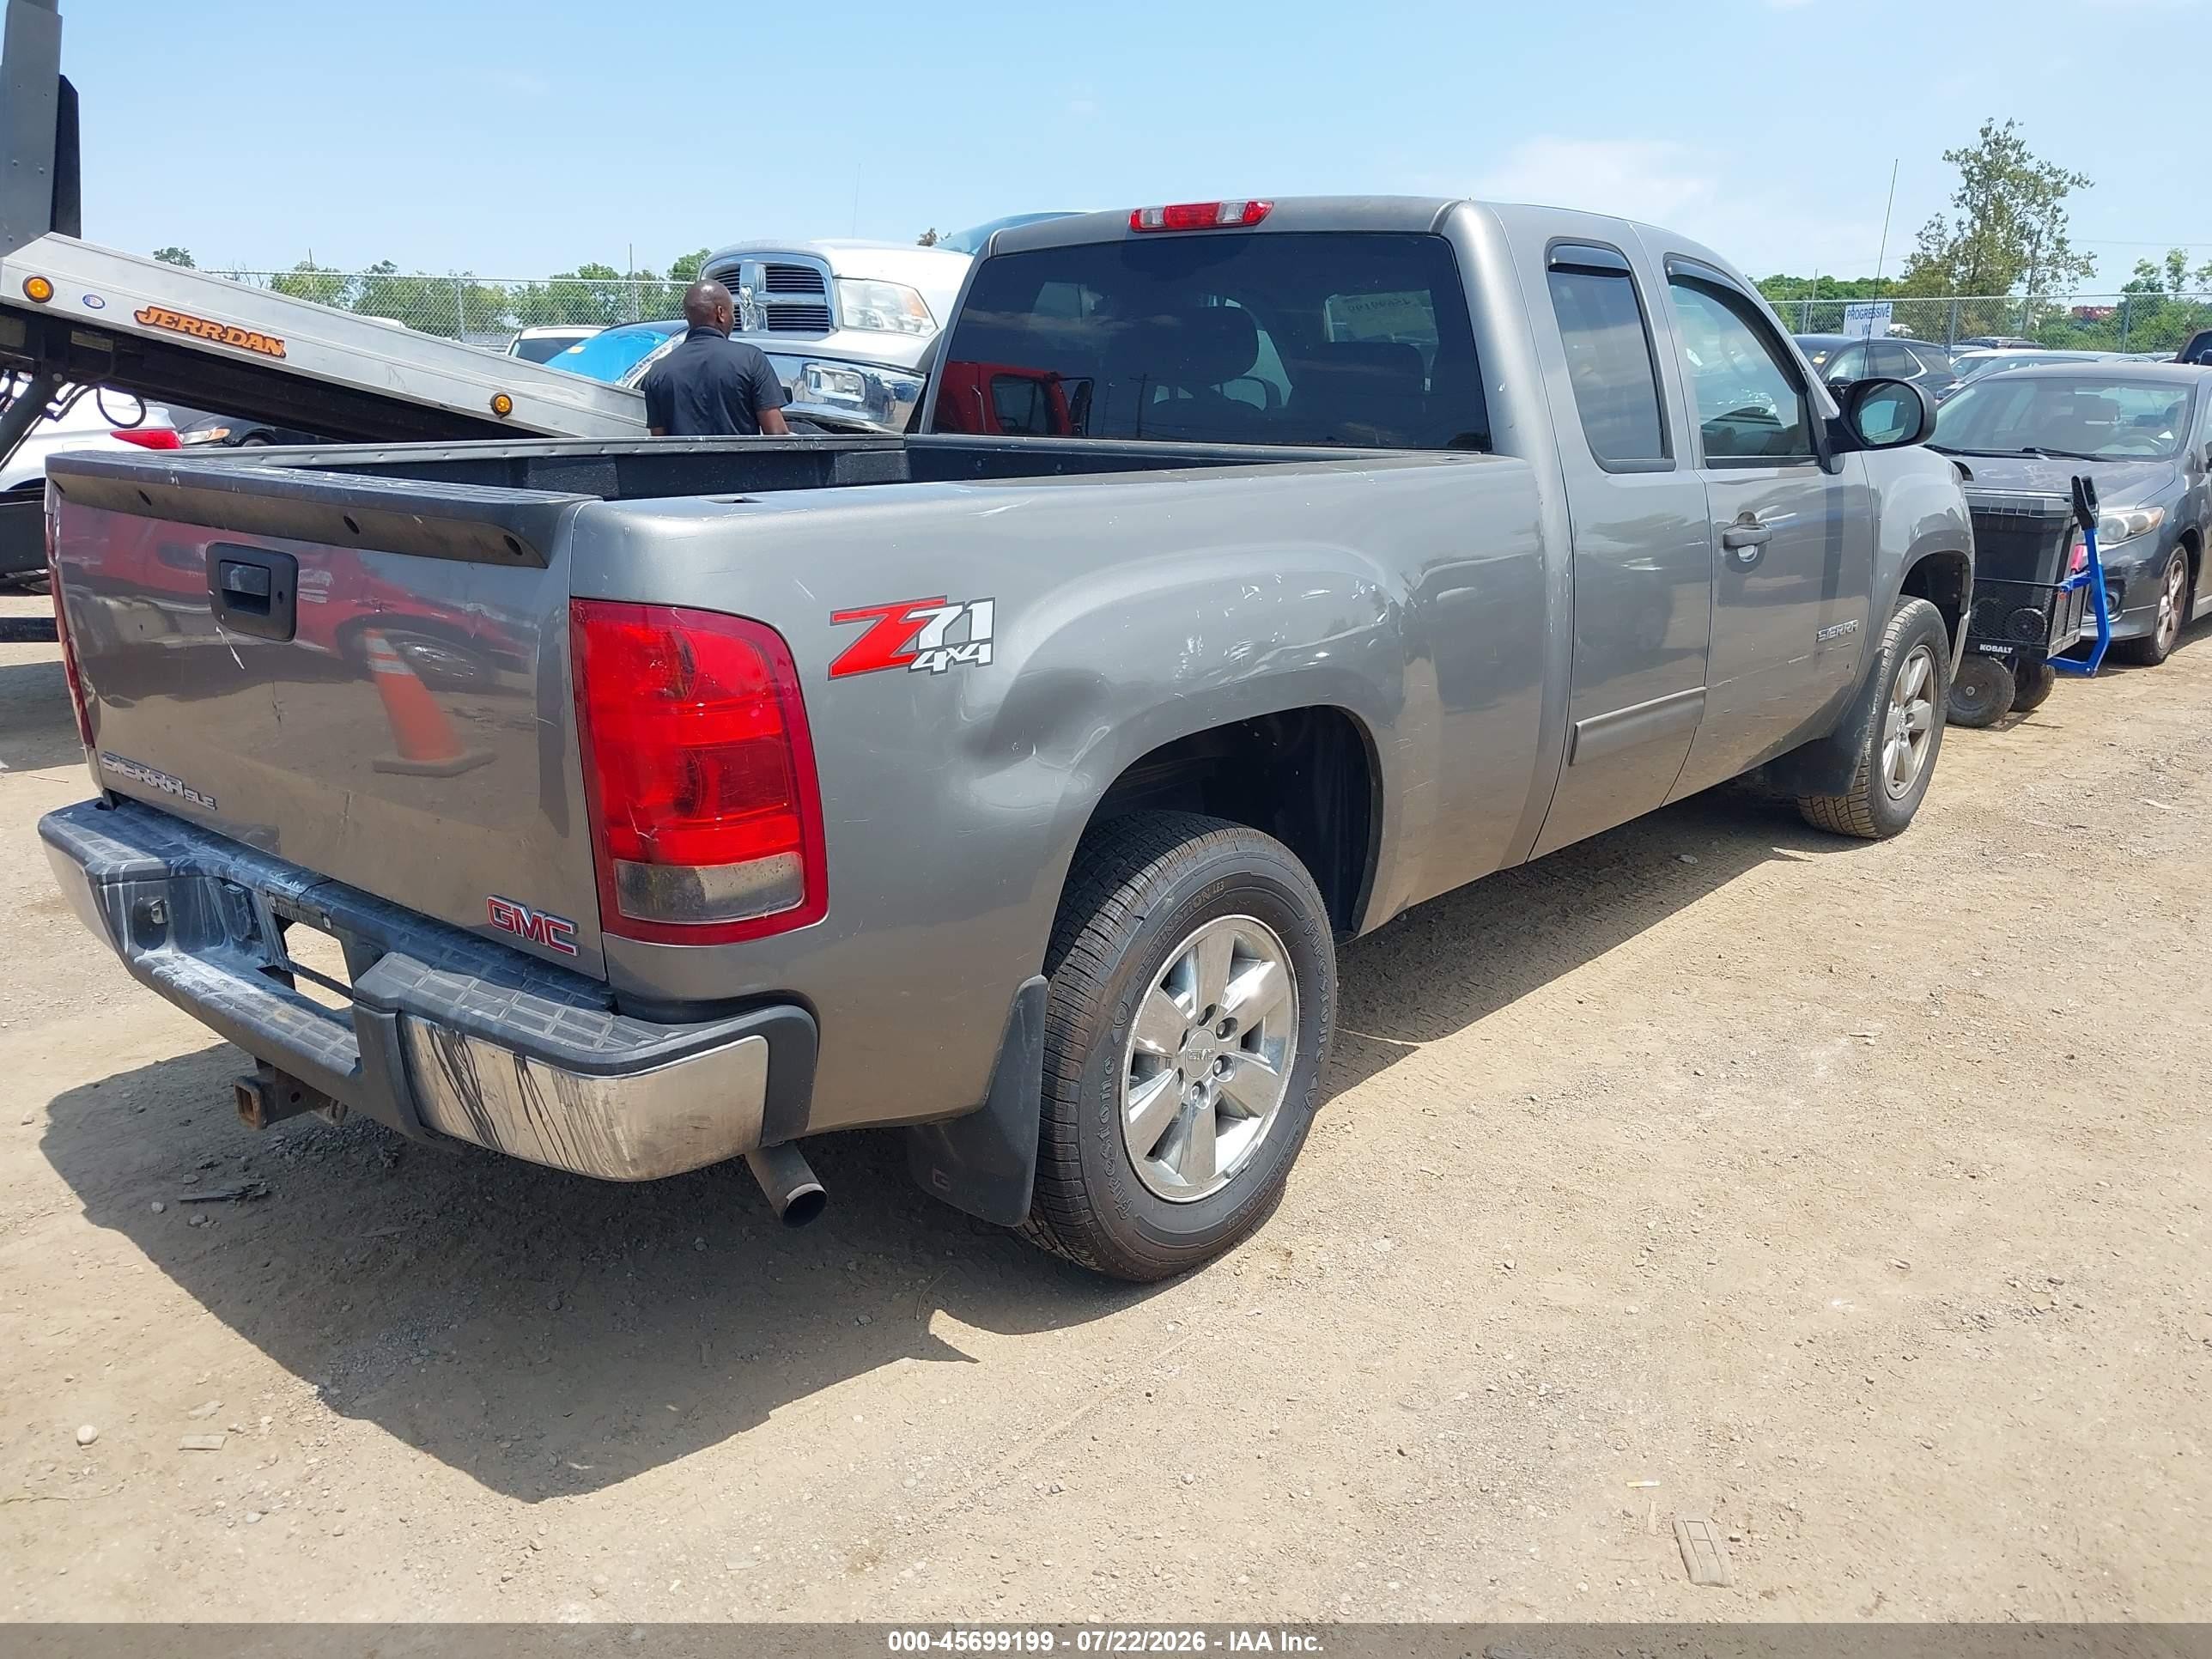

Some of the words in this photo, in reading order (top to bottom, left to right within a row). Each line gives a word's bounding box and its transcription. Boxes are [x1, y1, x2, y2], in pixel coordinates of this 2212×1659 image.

[1846, 307, 1890, 321] PROGRESSIVE
[828, 595, 996, 681] Z71
[1816, 619, 1859, 643] SIERRA
[1978, 643, 2014, 654] KOBALT
[101, 750, 185, 798] SIERRA
[184, 787, 218, 811] SLE
[487, 894, 580, 957] GMC
[1097, 1055, 1134, 1220] Firestone
